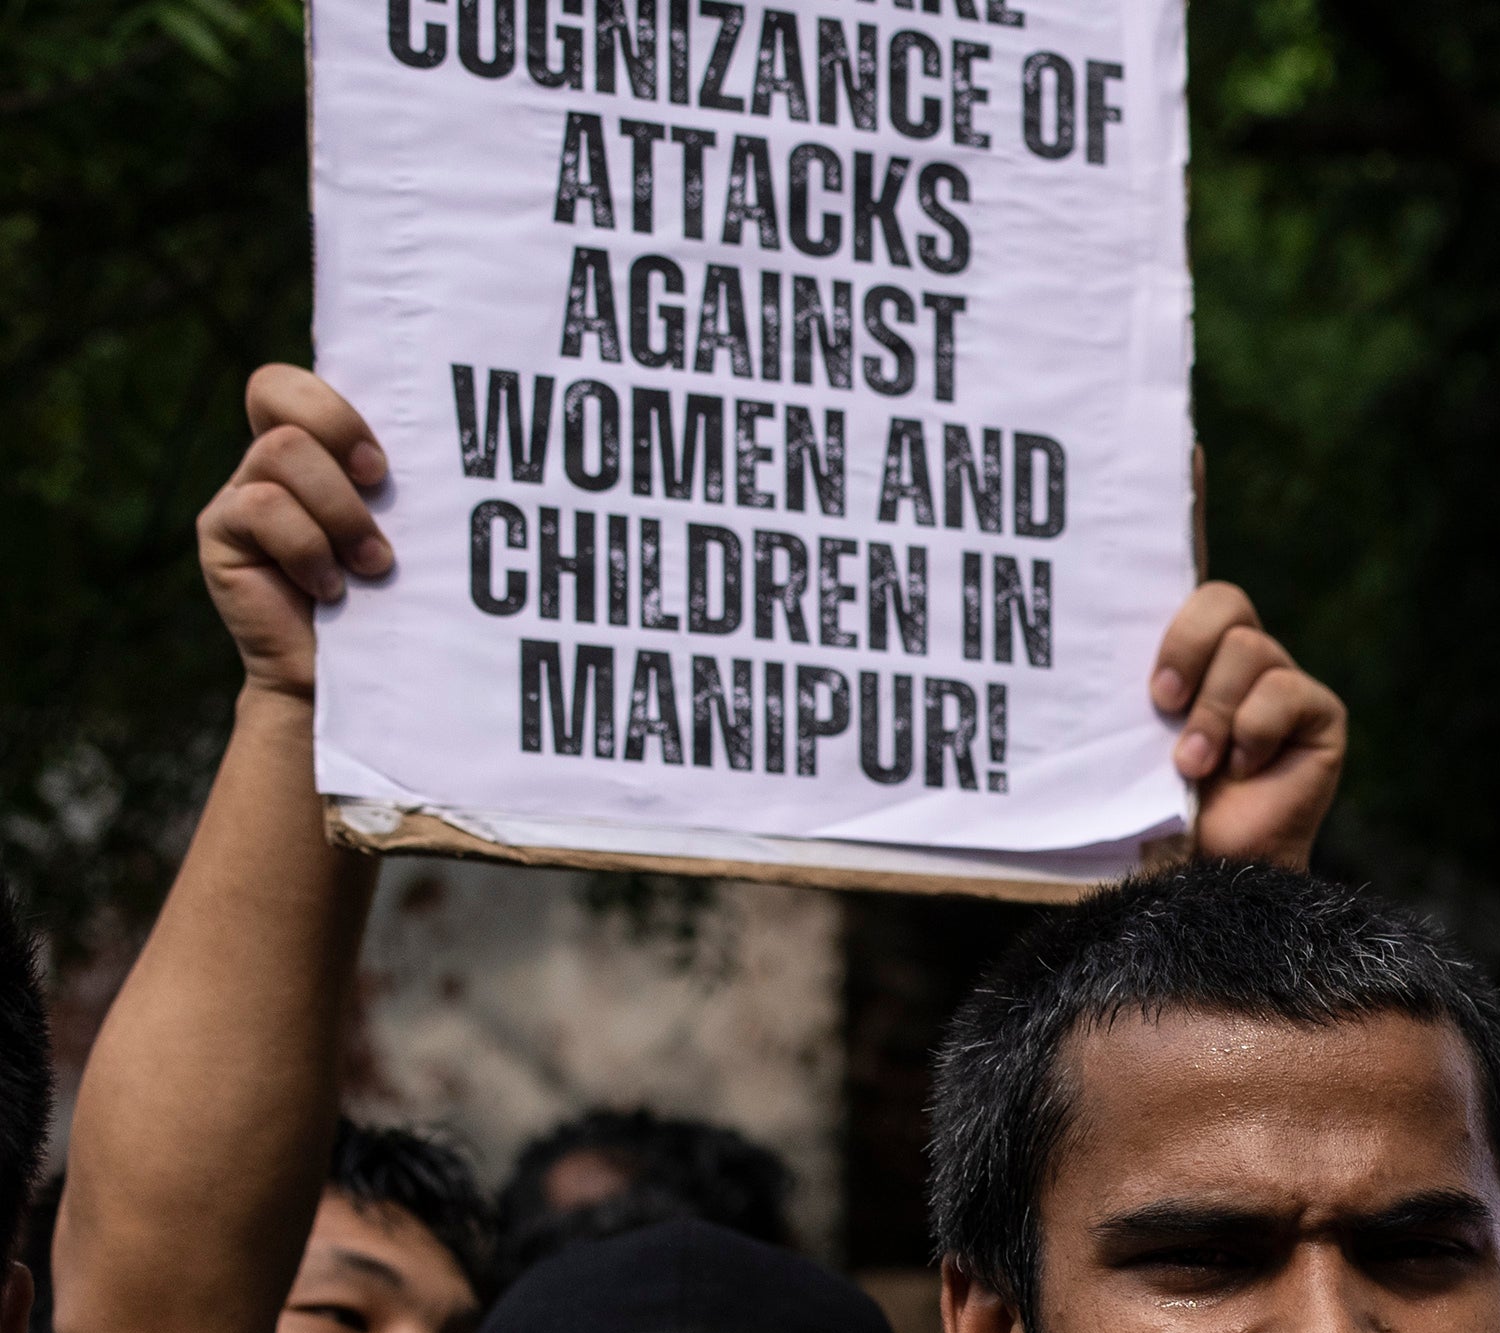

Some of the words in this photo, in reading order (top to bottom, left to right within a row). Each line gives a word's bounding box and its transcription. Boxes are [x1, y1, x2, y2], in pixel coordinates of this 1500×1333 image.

[388, 0, 990, 150] COGNIZANCE
[1023, 50, 1126, 164] OF
[553, 112, 973, 274] ATTACKS
[561, 247, 968, 402] AGAINST
[452, 364, 846, 518] WOMEN
[878, 418, 1068, 540] AND
[468, 500, 929, 656] CHILDREN
[961, 551, 1054, 668] IN
[519, 640, 1009, 793] MANIPUR!
